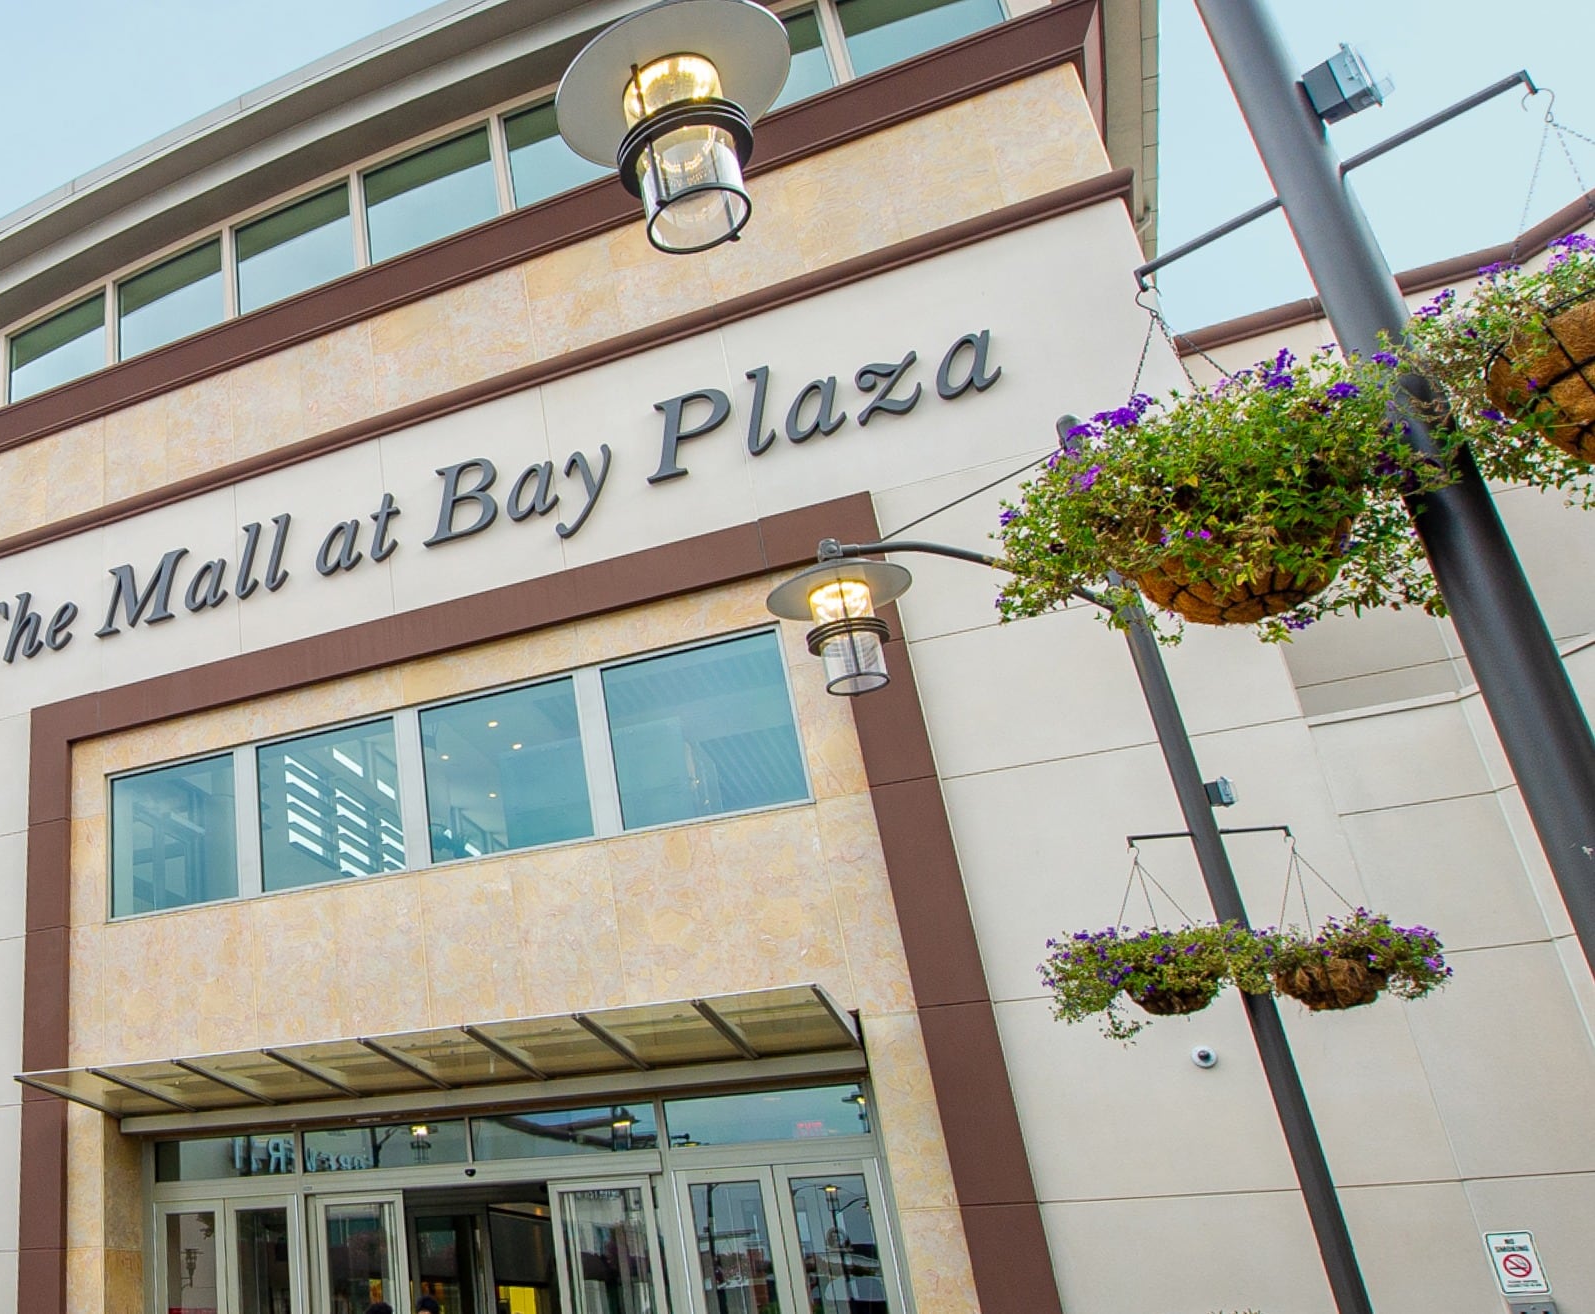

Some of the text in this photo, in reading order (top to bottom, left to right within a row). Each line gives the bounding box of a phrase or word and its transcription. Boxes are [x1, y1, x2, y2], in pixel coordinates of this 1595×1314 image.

[94, 511, 291, 639] Mall
[315, 492, 399, 576] at
[422, 442, 612, 550] Bay
[646, 328, 1003, 487] Plaza
